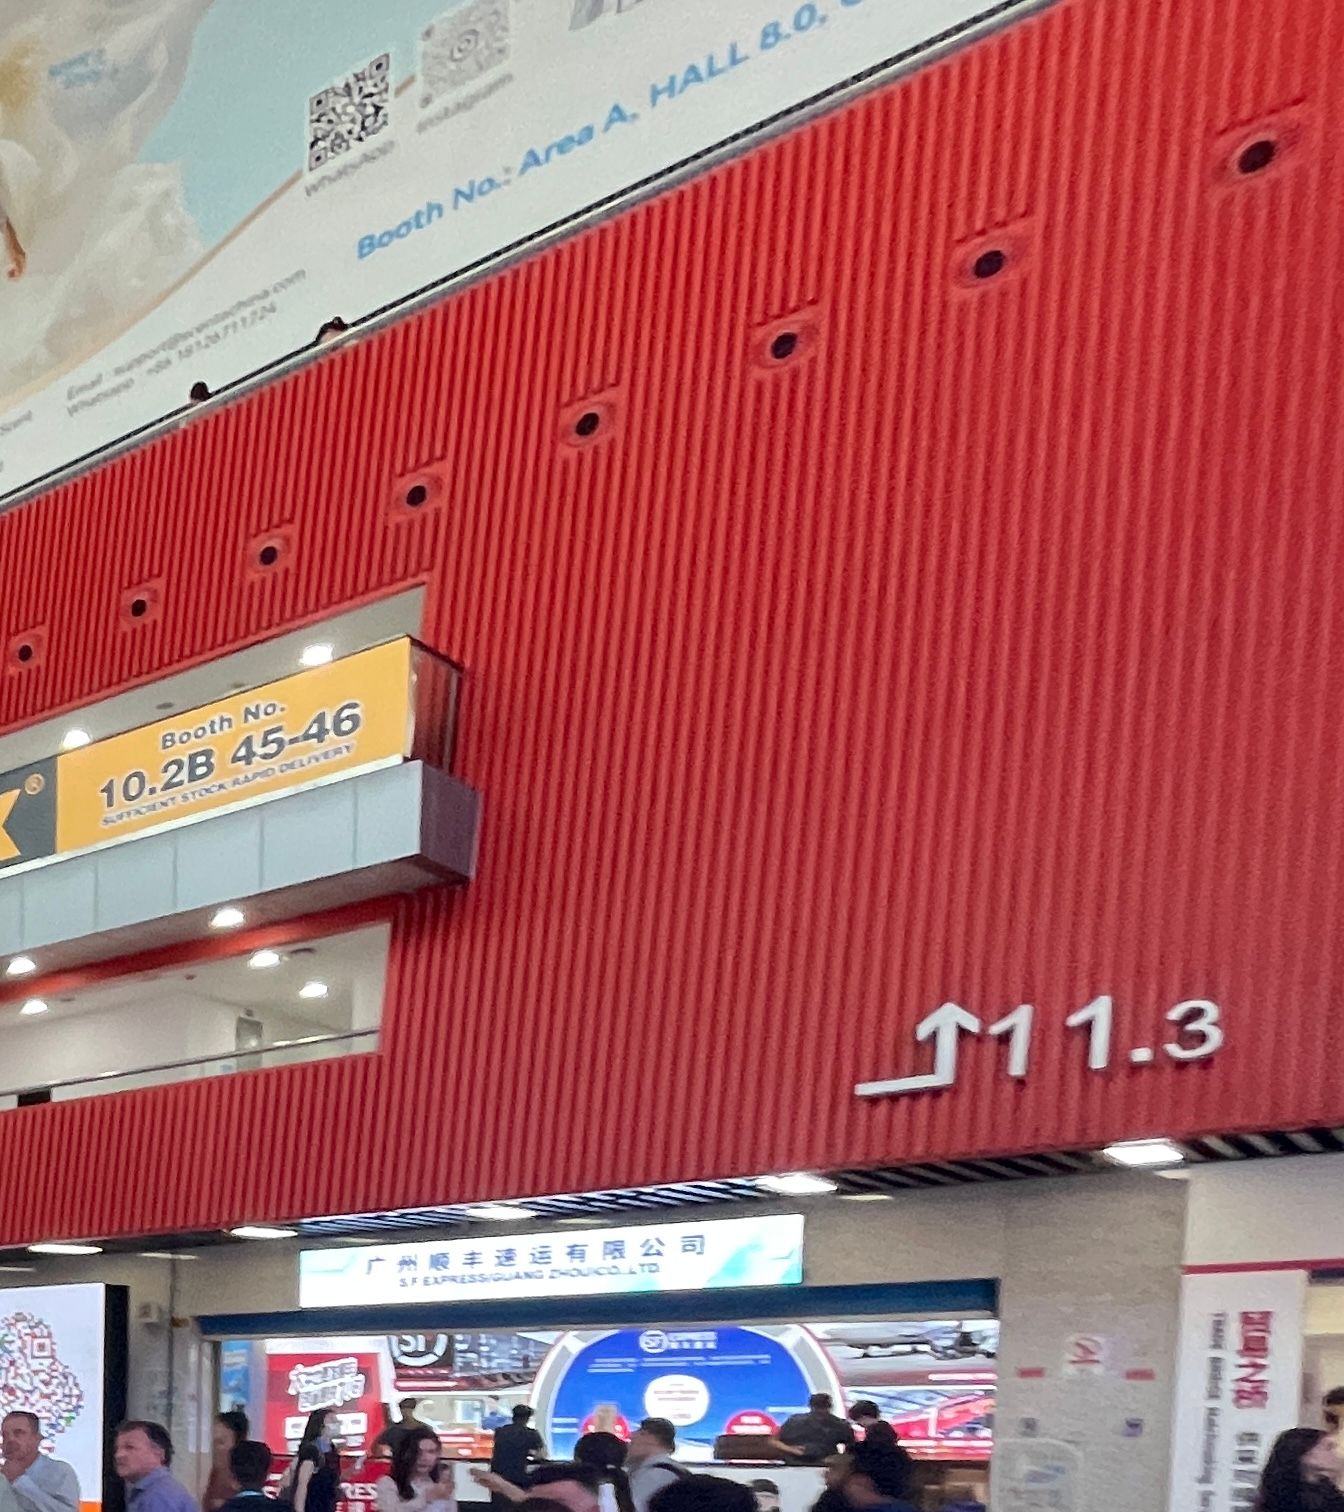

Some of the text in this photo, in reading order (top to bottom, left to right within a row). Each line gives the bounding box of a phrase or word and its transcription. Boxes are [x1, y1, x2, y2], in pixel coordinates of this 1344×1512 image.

[357, 200, 444, 260] Booth
[518, 124, 594, 177] Area
[650, 42, 749, 106] HALL
[101, 702, 361, 808] 10.2B 45-46
[162, 702, 286, 750] Booth No.
[181, 783, 227, 803] STOCK
[232, 766, 276, 788] RAPID
[280, 743, 352, 773] DELIVERY
[989, 995, 1224, 1078] 11.3
[366, 1234, 706, 1275] 广州顺丰速运有限公司
